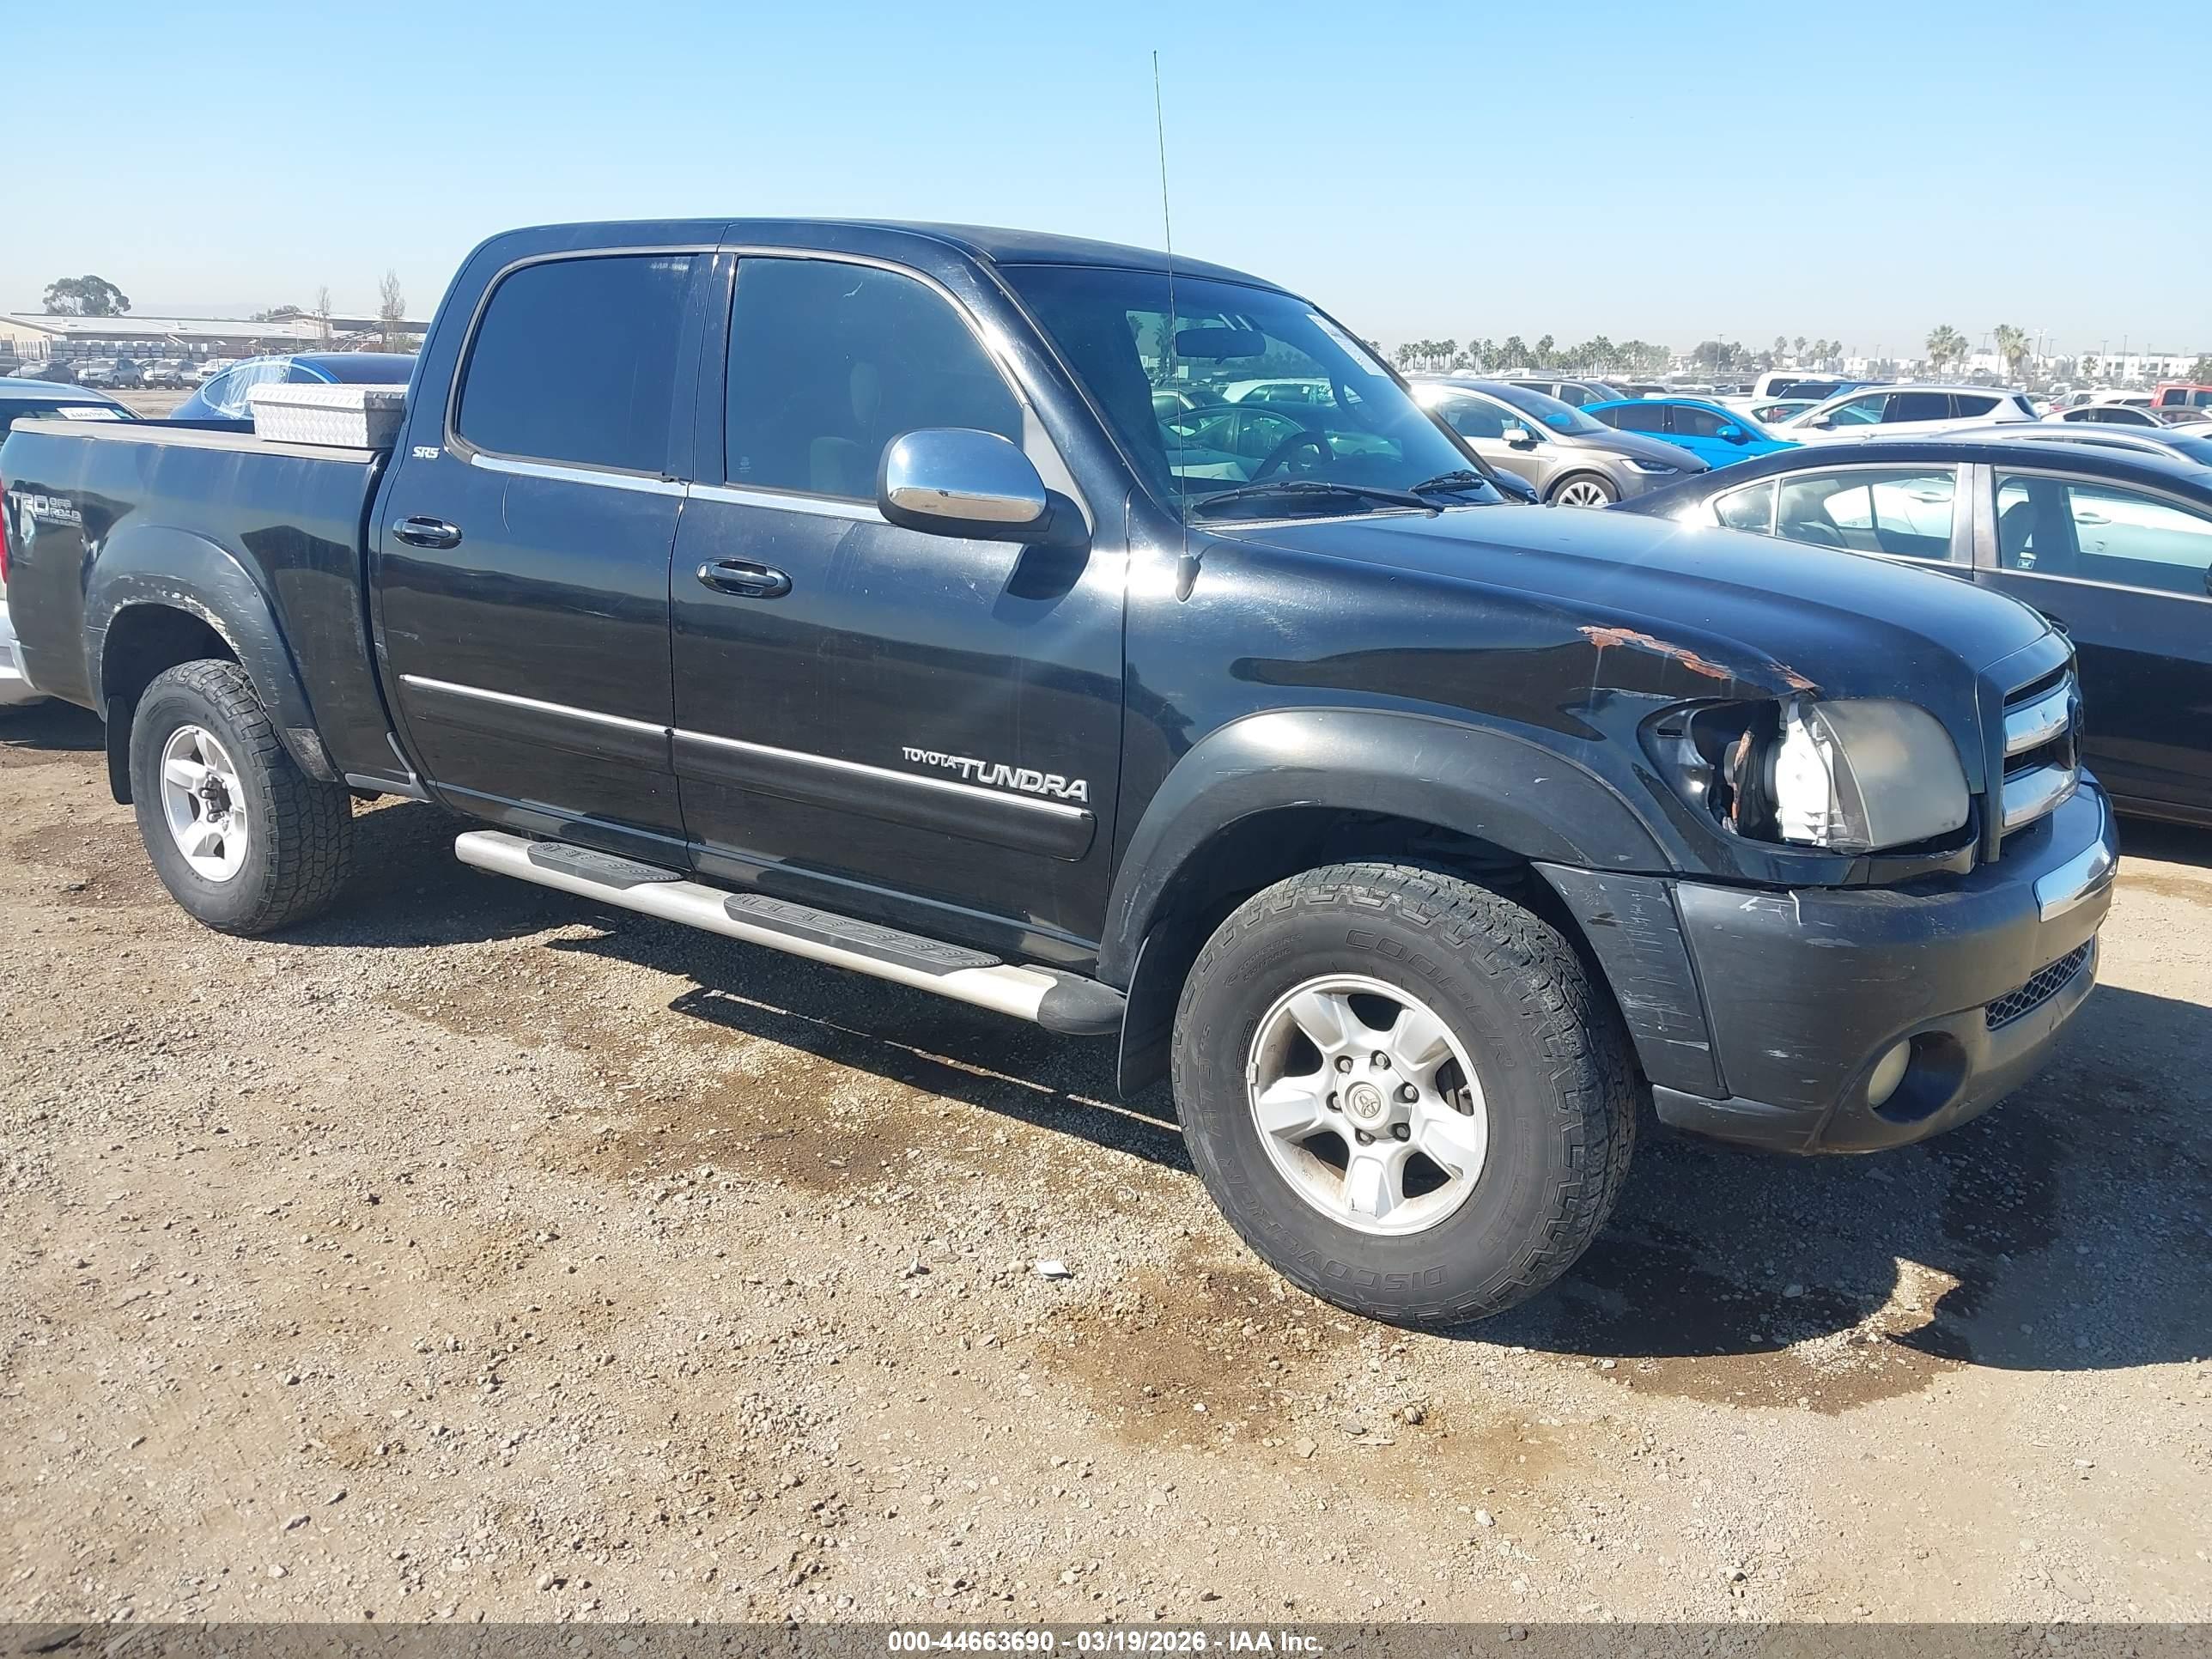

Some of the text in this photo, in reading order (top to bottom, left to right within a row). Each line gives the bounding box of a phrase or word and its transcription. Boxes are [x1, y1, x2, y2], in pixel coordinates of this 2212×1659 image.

[412, 446, 440, 459] SR5
[7, 489, 50, 518] TRD
[50, 507, 82, 522] ROAD
[902, 747, 1089, 803] TOYOTA TUNDRA
